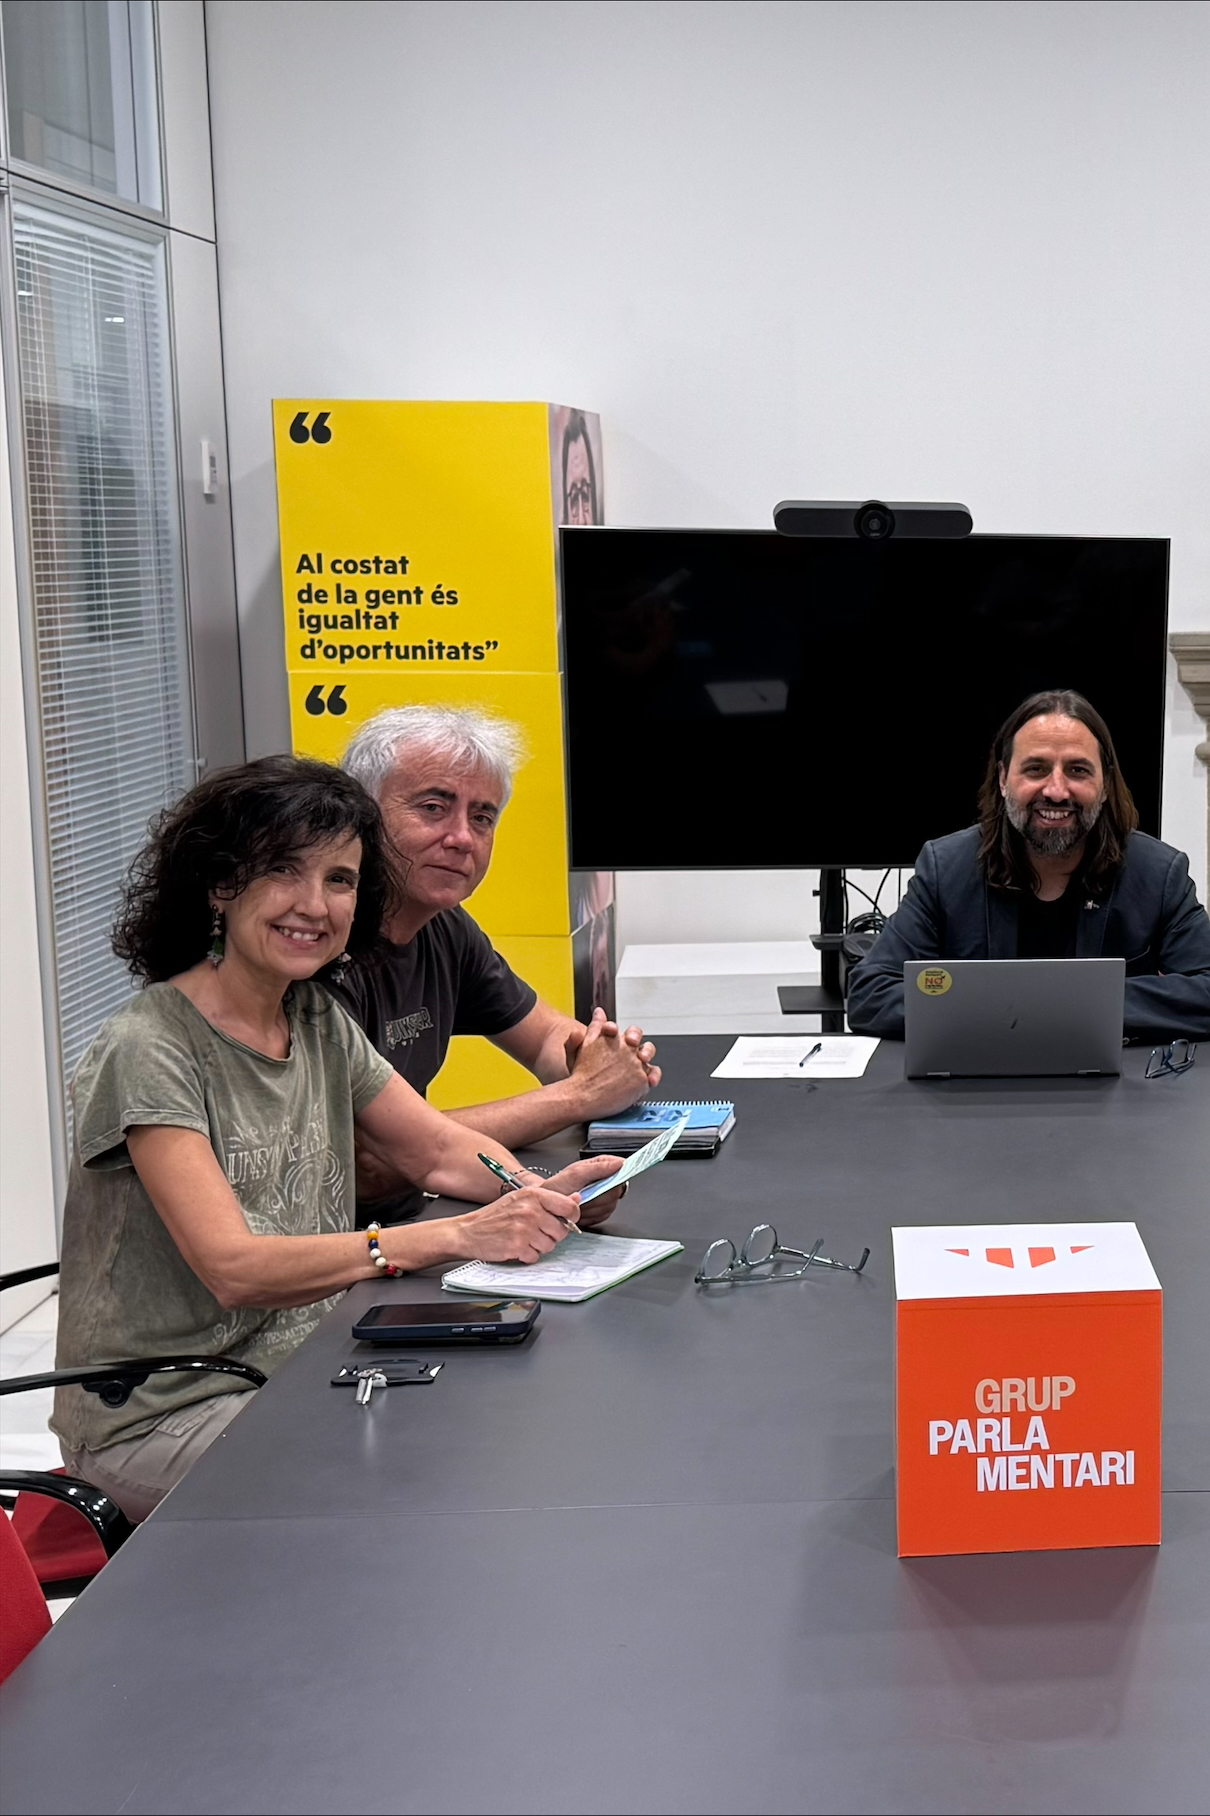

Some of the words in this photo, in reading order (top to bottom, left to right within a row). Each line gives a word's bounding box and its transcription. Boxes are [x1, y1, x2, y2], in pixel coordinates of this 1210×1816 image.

[296, 553, 323, 575] Al
[330, 555, 409, 575] costat
[297, 584, 328, 605] de
[336, 583, 358, 605] la
[365, 587, 423, 609] gent
[431, 584, 459, 605] és
[299, 609, 399, 634] igualtat
[975, 1375, 1076, 1414] GRUP
[928, 1415, 1050, 1456] PARLA
[976, 1450, 1135, 1492] MENTARI
